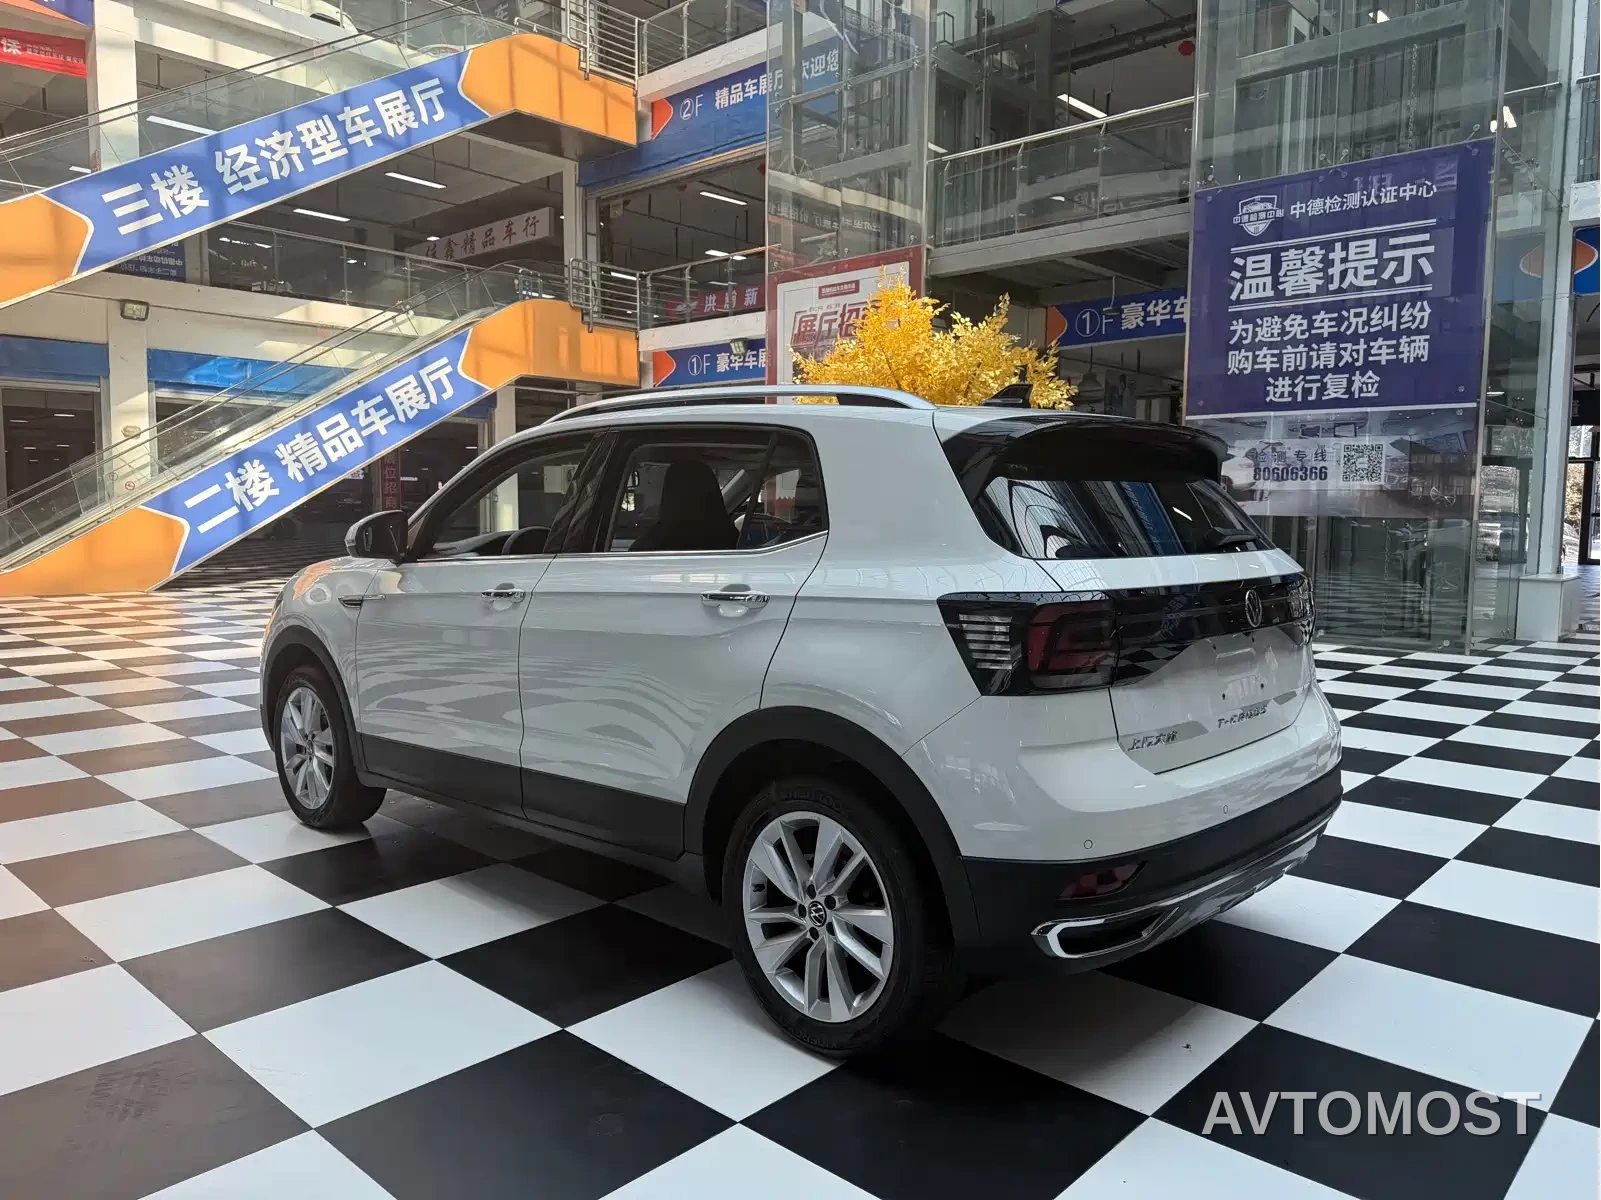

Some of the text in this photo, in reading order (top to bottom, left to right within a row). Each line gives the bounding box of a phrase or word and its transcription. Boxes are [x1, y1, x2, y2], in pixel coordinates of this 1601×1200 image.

[714, 69, 784, 110] 精品车展厅
[102, 77, 445, 235] 三楼 经济型车展厅
[1290, 180, 1438, 218] 中德检测认证中心
[1229, 233, 1435, 301] 温馨提示
[1121, 295, 1189, 330] 豪华车
[1229, 300, 1432, 345] 为避免车况纠纷
[1227, 335, 1431, 375] 购车前请对车辆
[1266, 370, 1381, 403] 进行复检
[183, 356, 454, 533] 二楼 精品车展厅
[1253, 465, 1329, 482] 80606366
